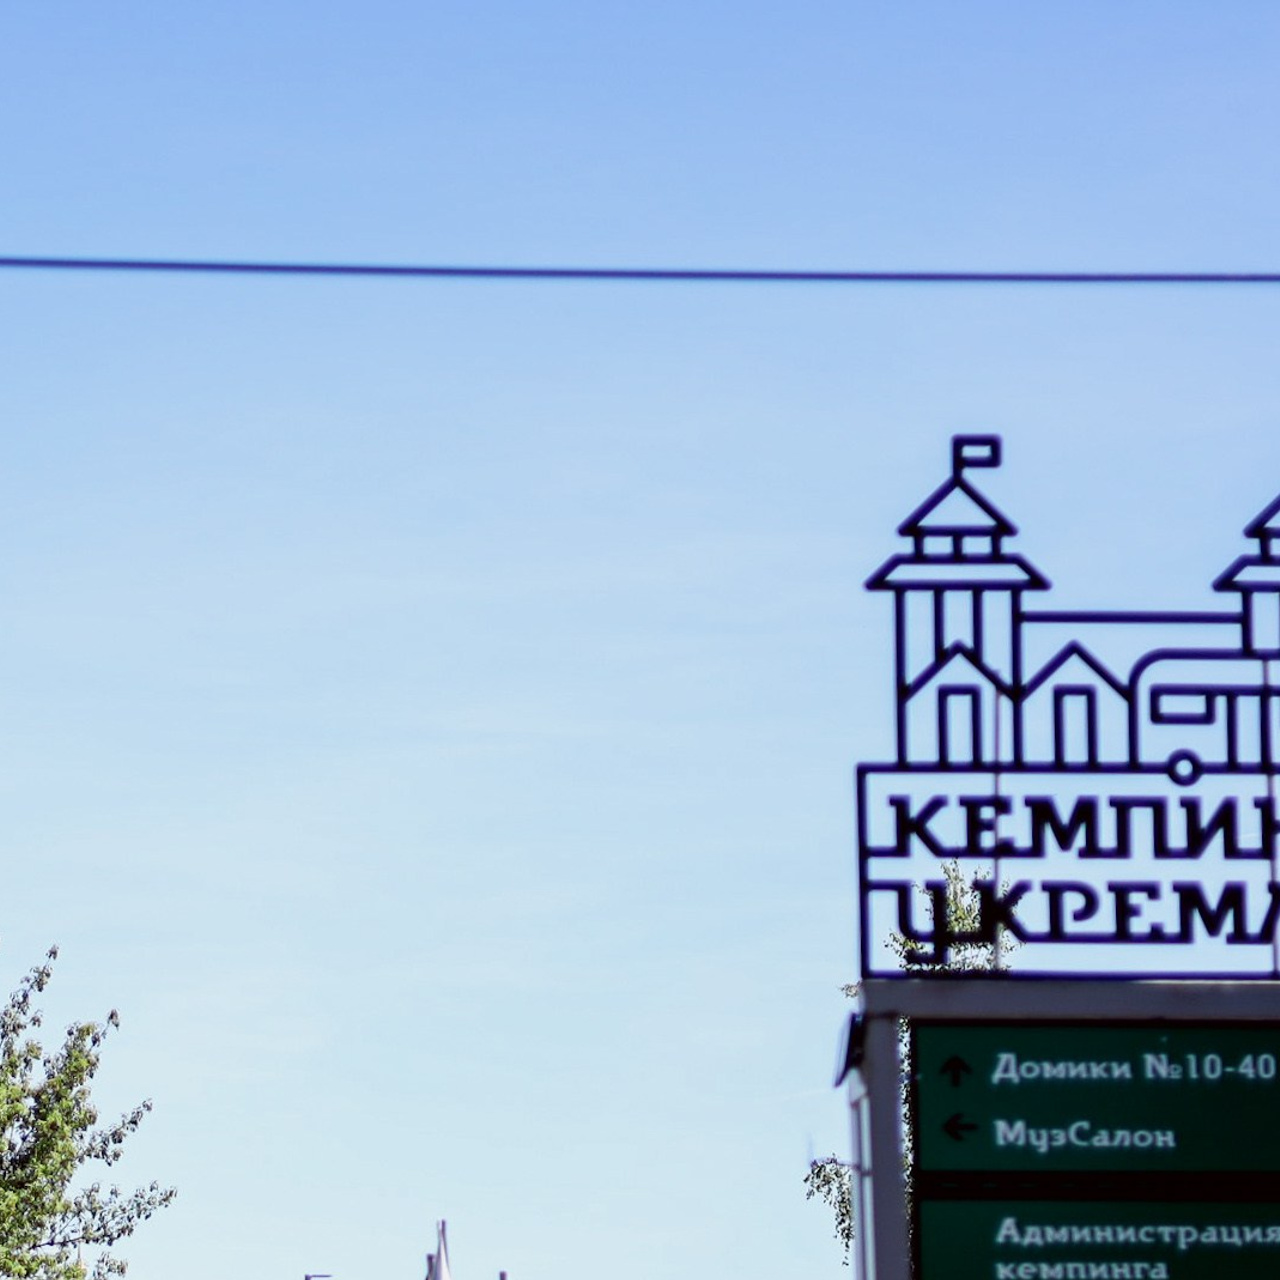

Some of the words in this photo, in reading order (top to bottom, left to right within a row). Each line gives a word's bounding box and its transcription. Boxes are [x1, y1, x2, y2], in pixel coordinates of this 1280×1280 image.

[973, 880, 1280, 945] КРЕМ
[991, 1051, 1133, 1085] Домики
[1143, 1052, 1276, 1081] №10-40
[993, 1118, 1176, 1154] МузСалон
[995, 1216, 1280, 1251] Администрация
